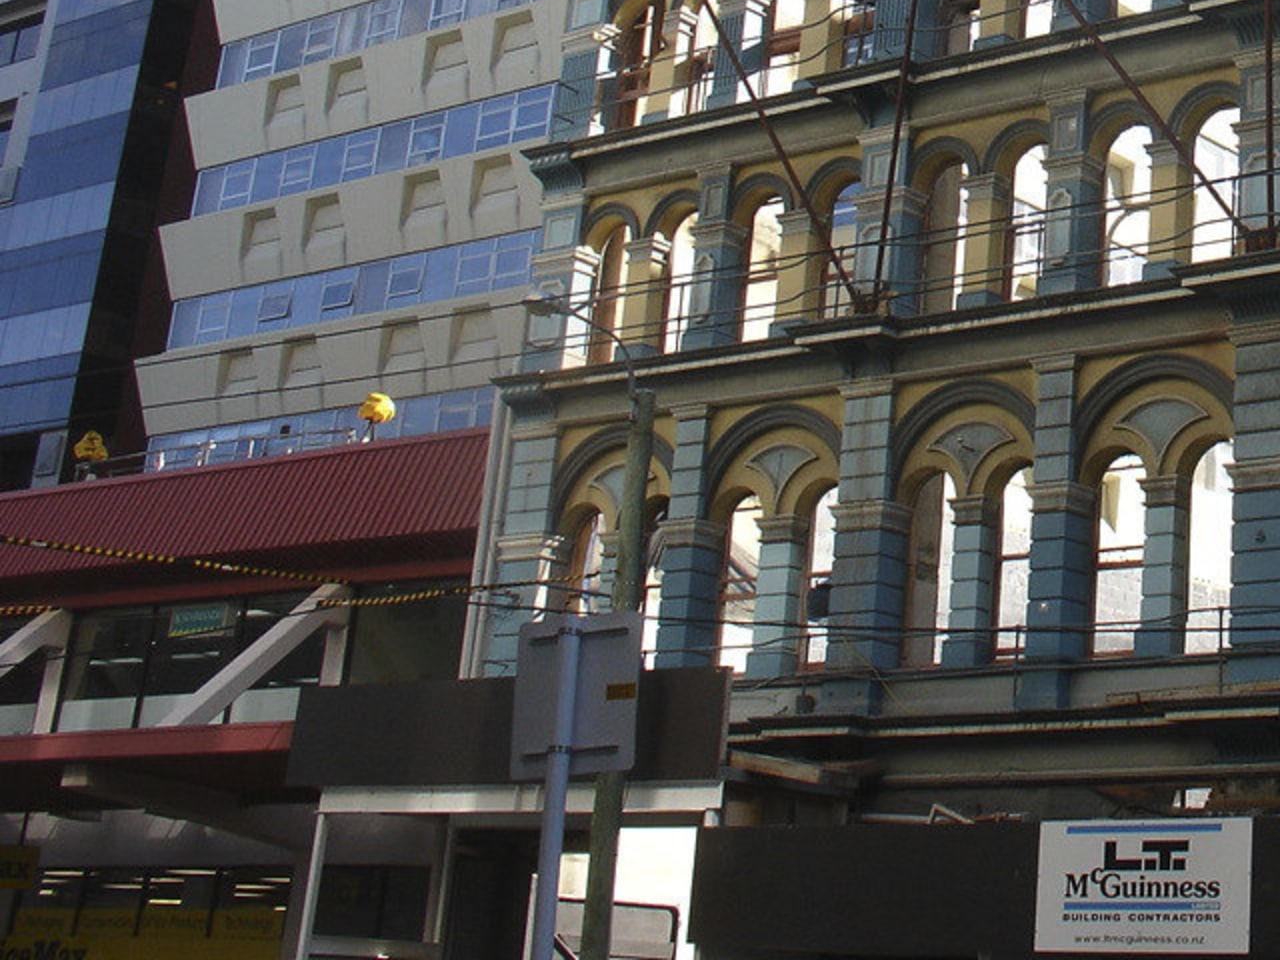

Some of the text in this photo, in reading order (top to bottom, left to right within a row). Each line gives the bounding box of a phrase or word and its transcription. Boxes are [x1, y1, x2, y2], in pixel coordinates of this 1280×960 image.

[1065, 867, 1222, 899] McGuinness
[1062, 912, 1221, 922] BUILDING CONTRACTORS
